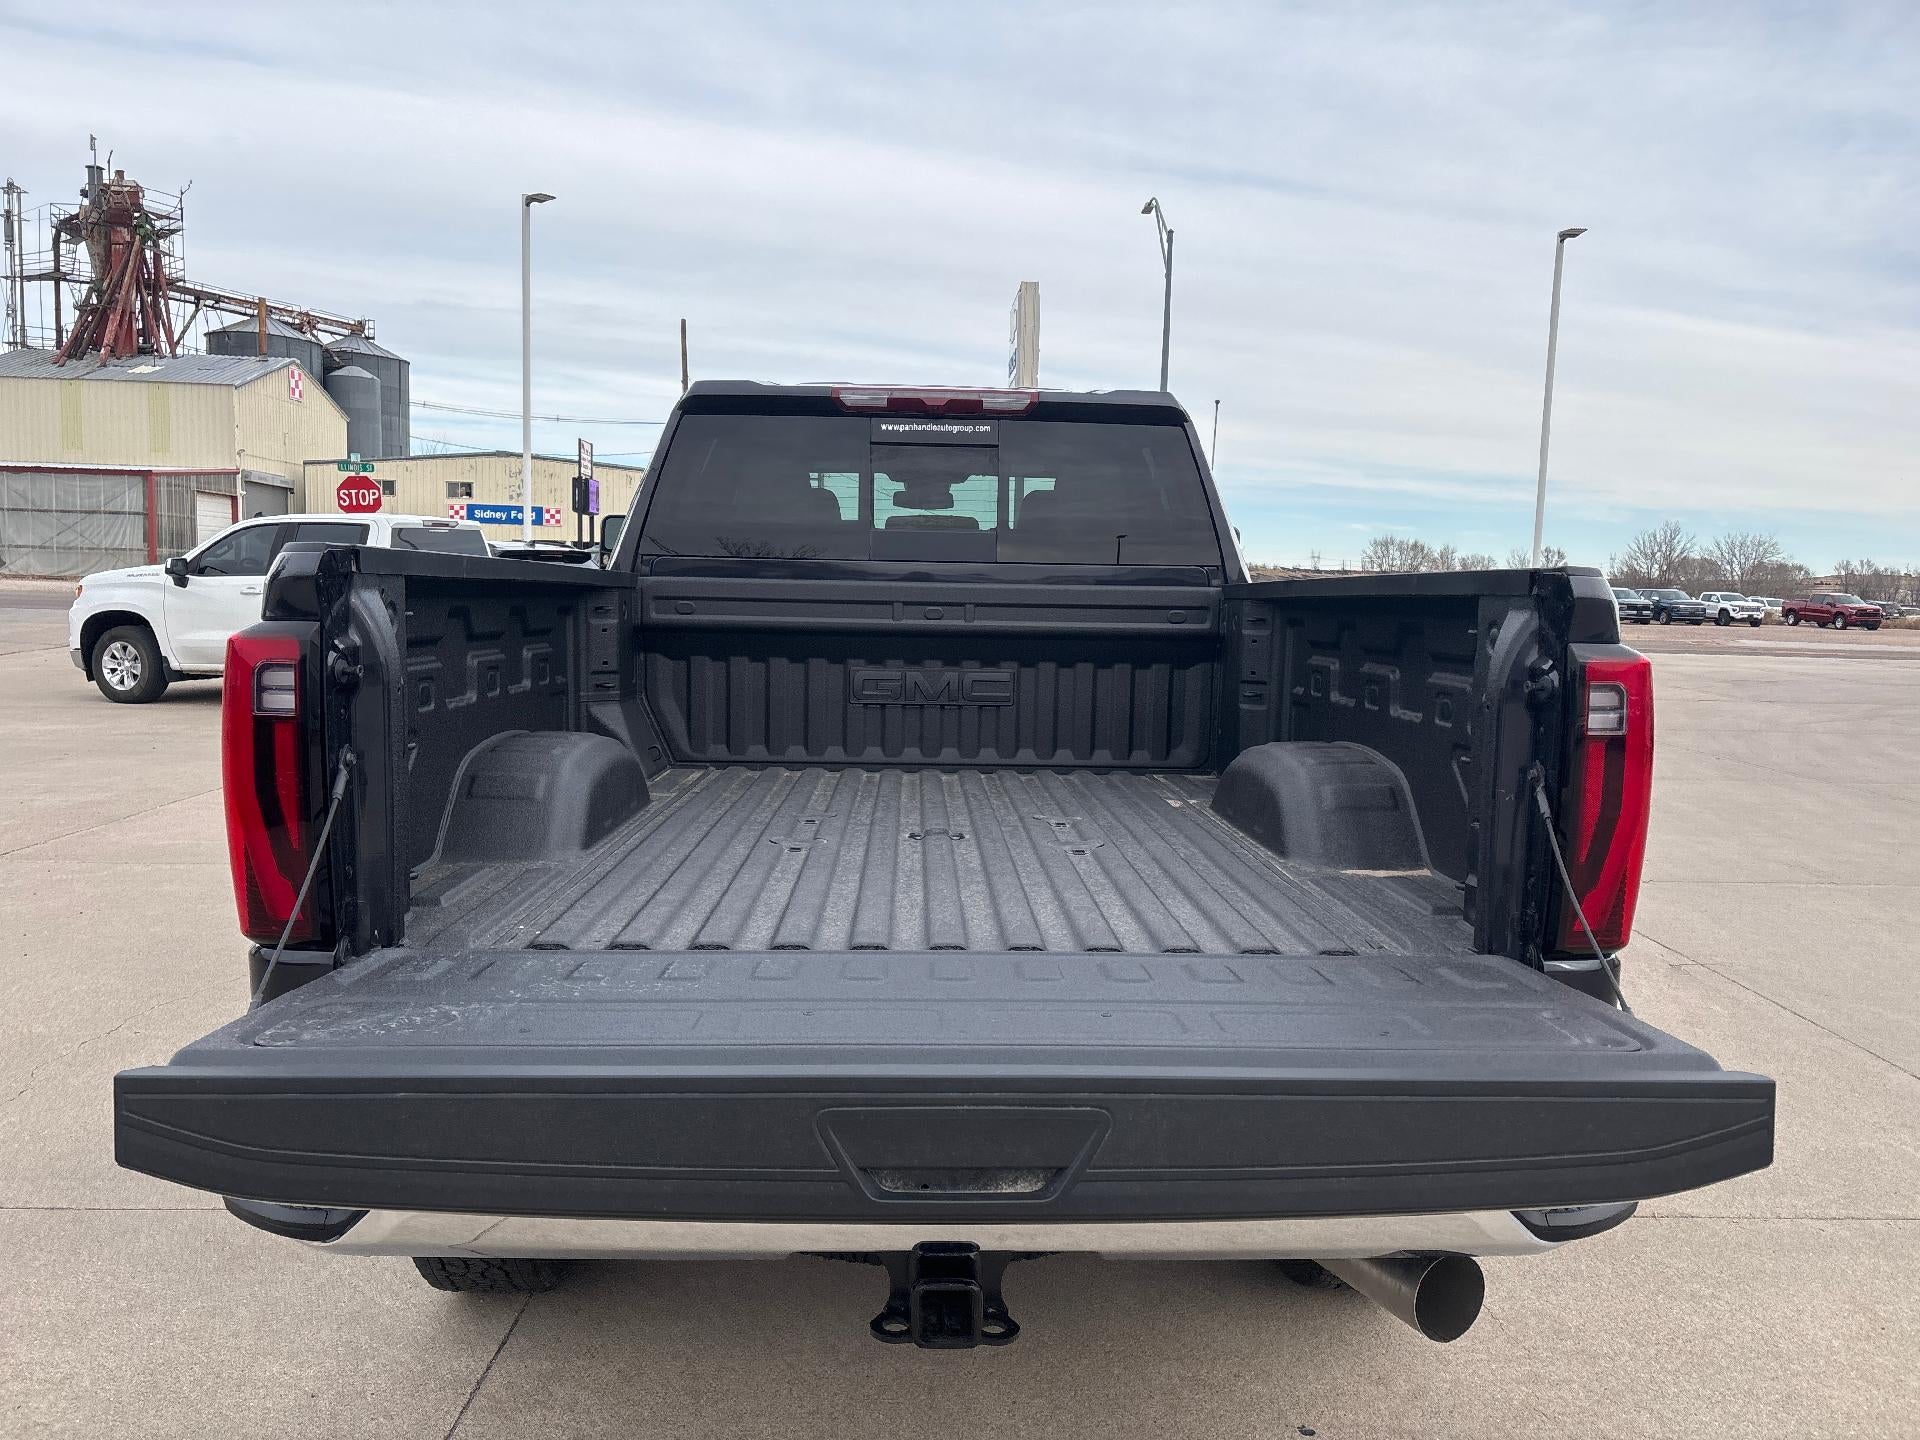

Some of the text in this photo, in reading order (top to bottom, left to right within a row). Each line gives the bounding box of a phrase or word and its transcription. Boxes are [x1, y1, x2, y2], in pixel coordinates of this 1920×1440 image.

[880, 422, 991, 434] www.panhandleautogroup.com
[339, 489, 380, 506] STOP
[474, 509, 536, 521] Sidney Fed
[852, 670, 1012, 702] GMC
